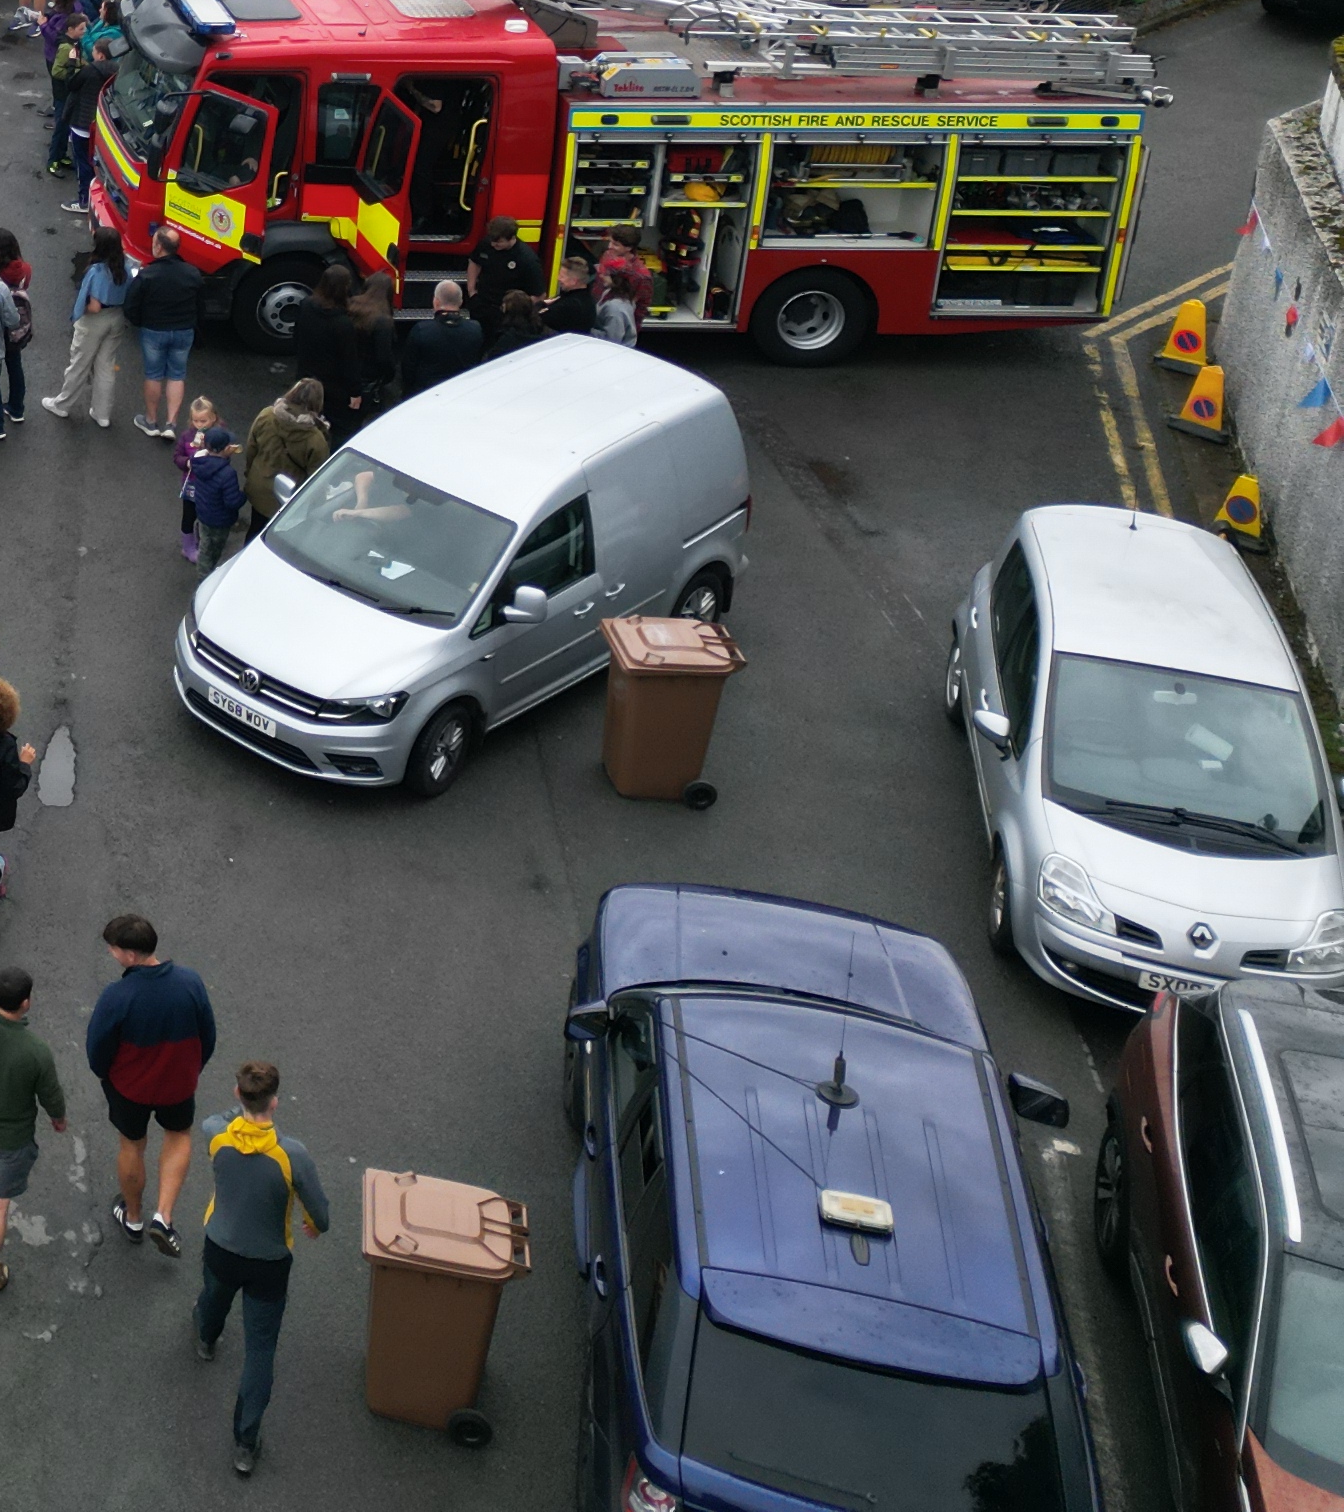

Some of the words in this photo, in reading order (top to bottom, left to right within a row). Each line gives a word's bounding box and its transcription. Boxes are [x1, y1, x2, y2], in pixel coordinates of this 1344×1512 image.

[720, 115, 792, 127] SCOTTISH
[798, 115, 829, 127] FIRE
[834, 115, 865, 127] AND
[871, 115, 930, 127] RESCUE
[937, 115, 999, 127] SERVICE
[213, 691, 242, 717] SY68
[245, 709, 269, 731] WOV
